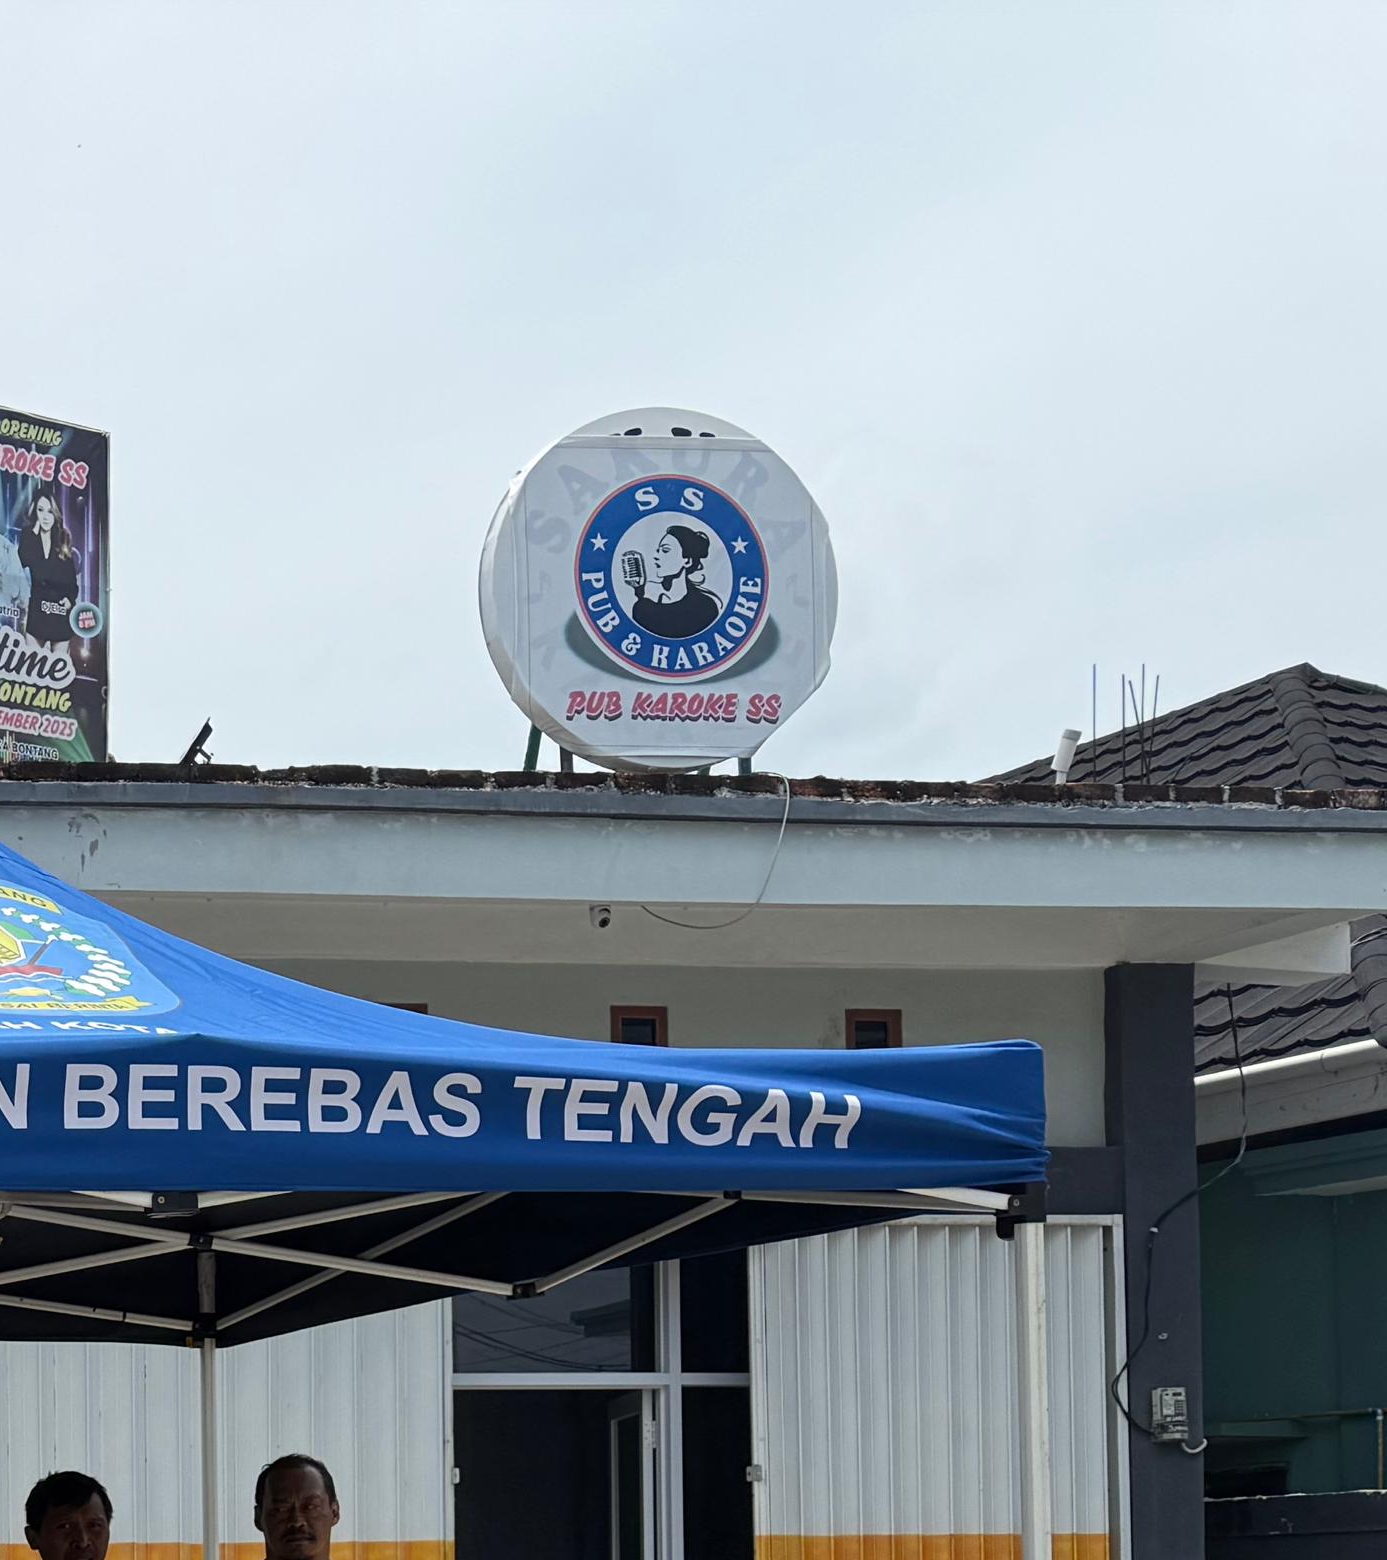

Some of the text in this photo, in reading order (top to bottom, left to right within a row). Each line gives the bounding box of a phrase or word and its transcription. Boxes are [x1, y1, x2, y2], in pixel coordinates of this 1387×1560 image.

[0, 418, 63, 446] OPENING
[59, 459, 89, 489] SS
[581, 571, 762, 671] PUB & KARAOKE
[565, 690, 784, 725] PUB KAROKE SS
[42, 717, 76, 738] 2025
[12, 742, 59, 760] BONTANG
[62, 1062, 483, 1138] BEREBAS
[513, 1075, 862, 1149] TENGAH
